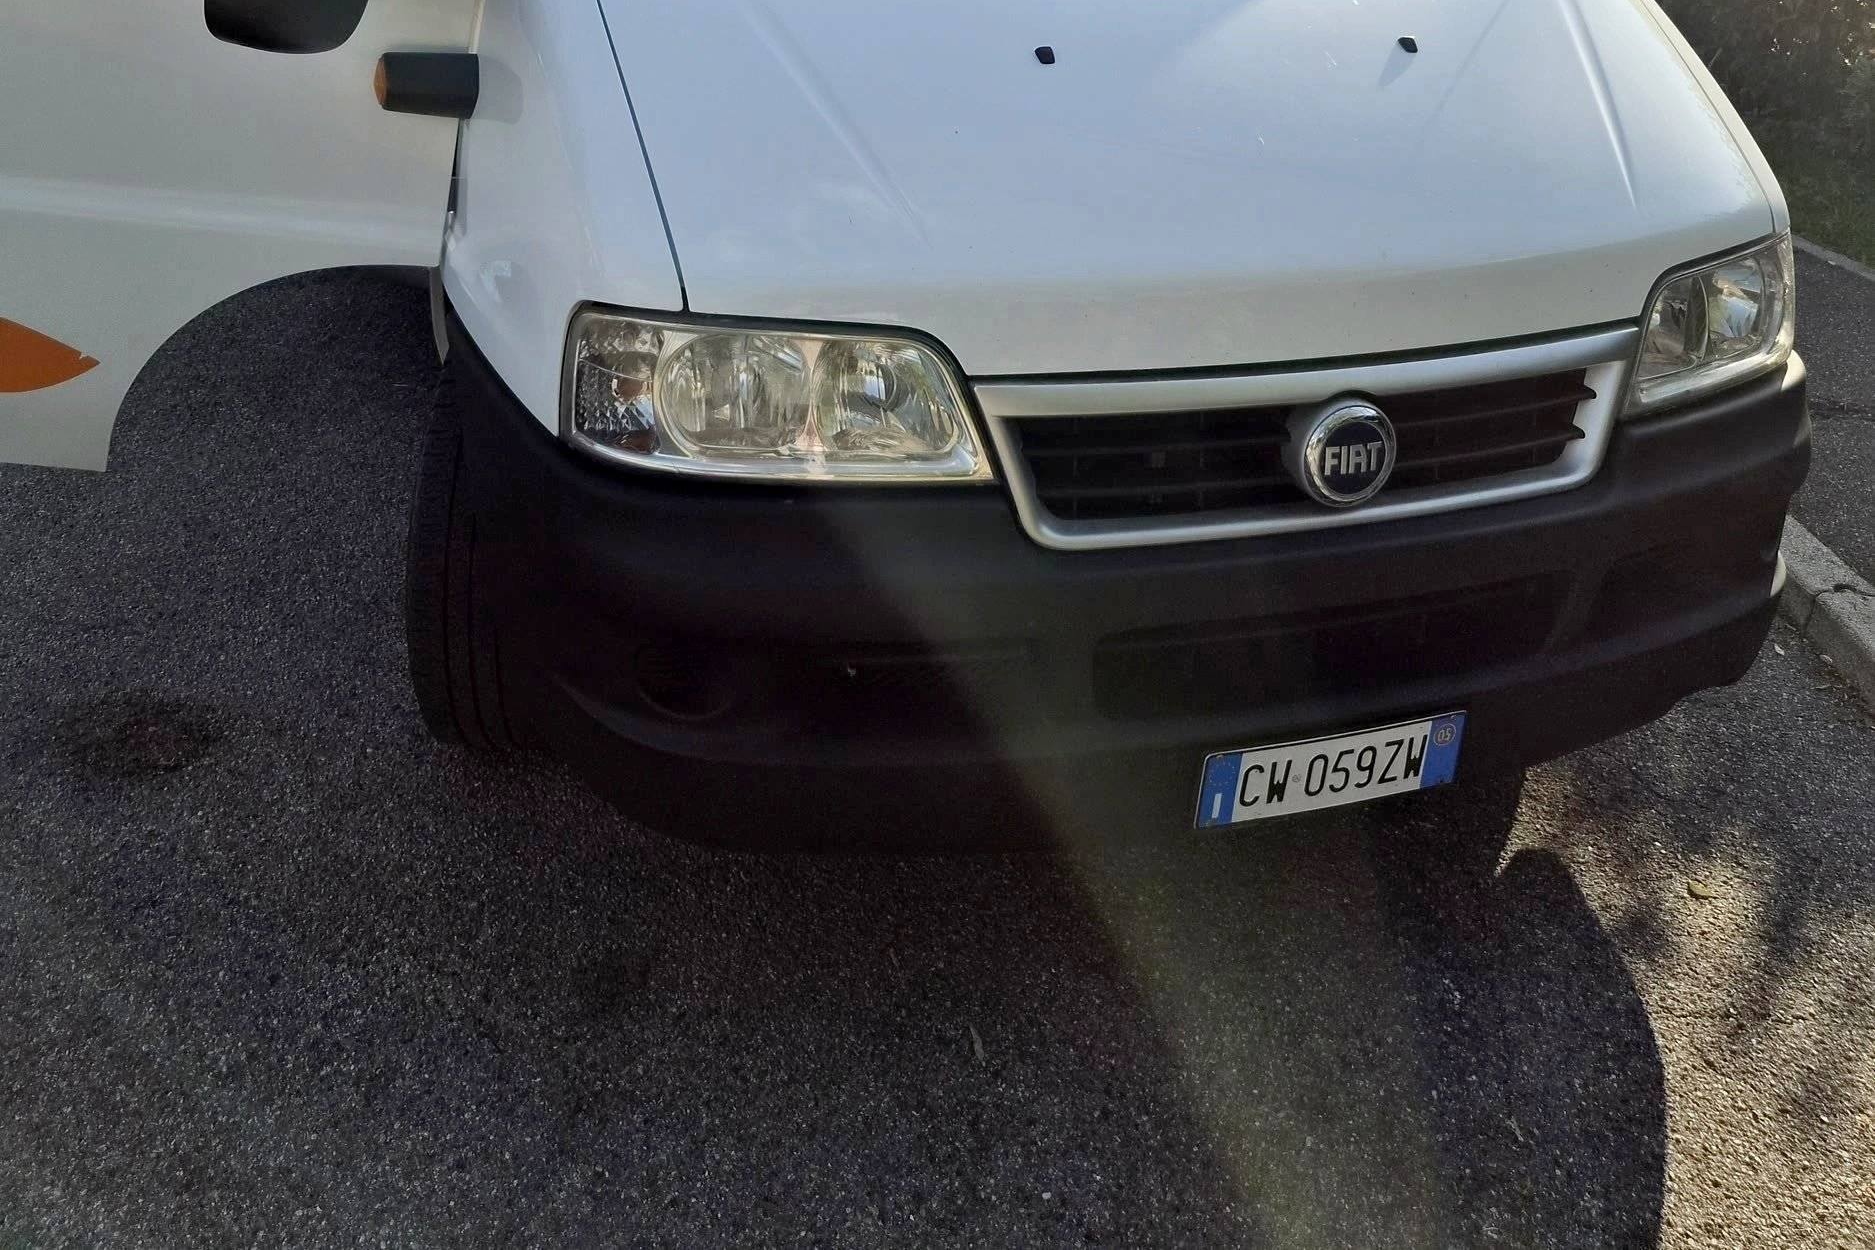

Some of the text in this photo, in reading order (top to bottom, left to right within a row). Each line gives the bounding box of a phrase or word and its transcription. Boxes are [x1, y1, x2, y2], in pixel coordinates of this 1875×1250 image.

[1324, 441, 1383, 476] FIAT
[1239, 760, 1292, 807] CW
[1304, 734, 1428, 797] 059ZW
